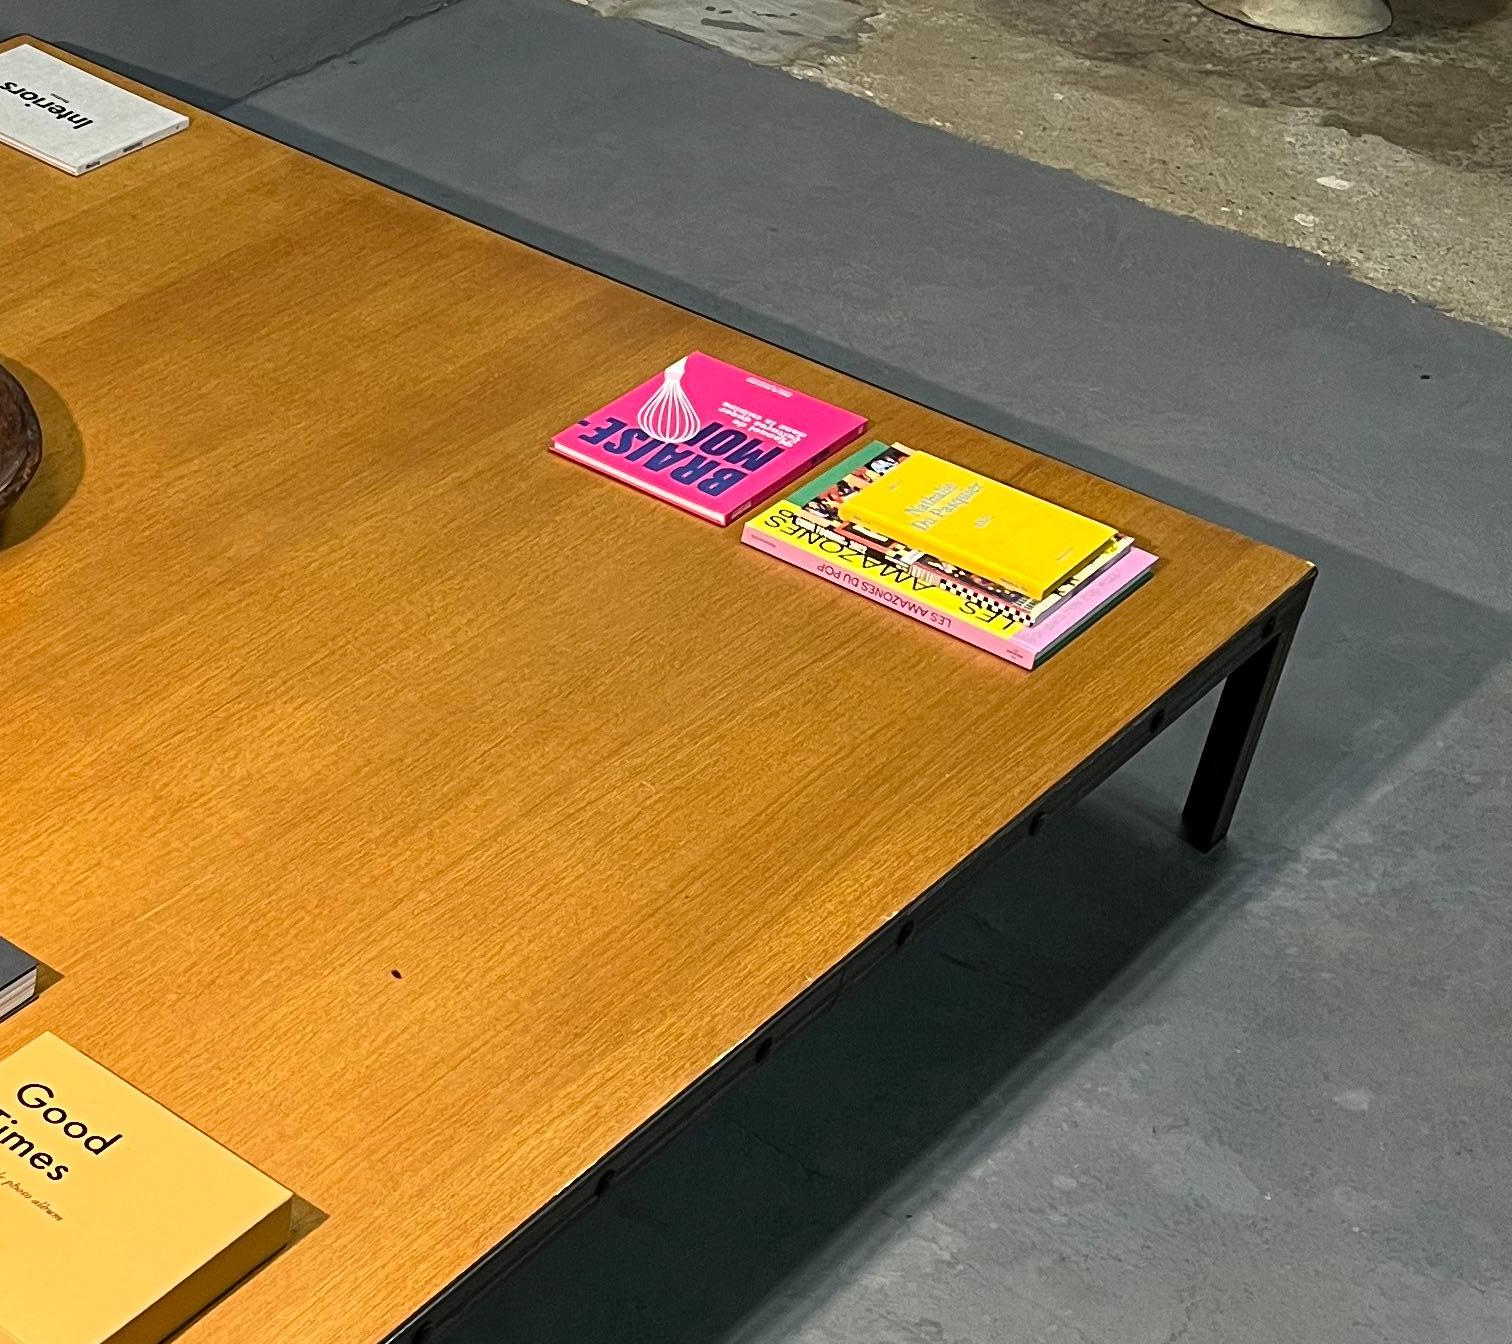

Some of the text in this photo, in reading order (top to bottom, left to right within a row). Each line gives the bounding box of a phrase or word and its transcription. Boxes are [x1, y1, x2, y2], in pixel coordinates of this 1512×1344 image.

[0, 81, 93, 130] Interiors
[683, 422, 786, 472] MOI
[764, 515, 937, 591] AMAZONES
[817, 563, 953, 629] LES AMAZONES DU POP
[959, 601, 1016, 630] LES
[16, 1083, 123, 1156] Good
